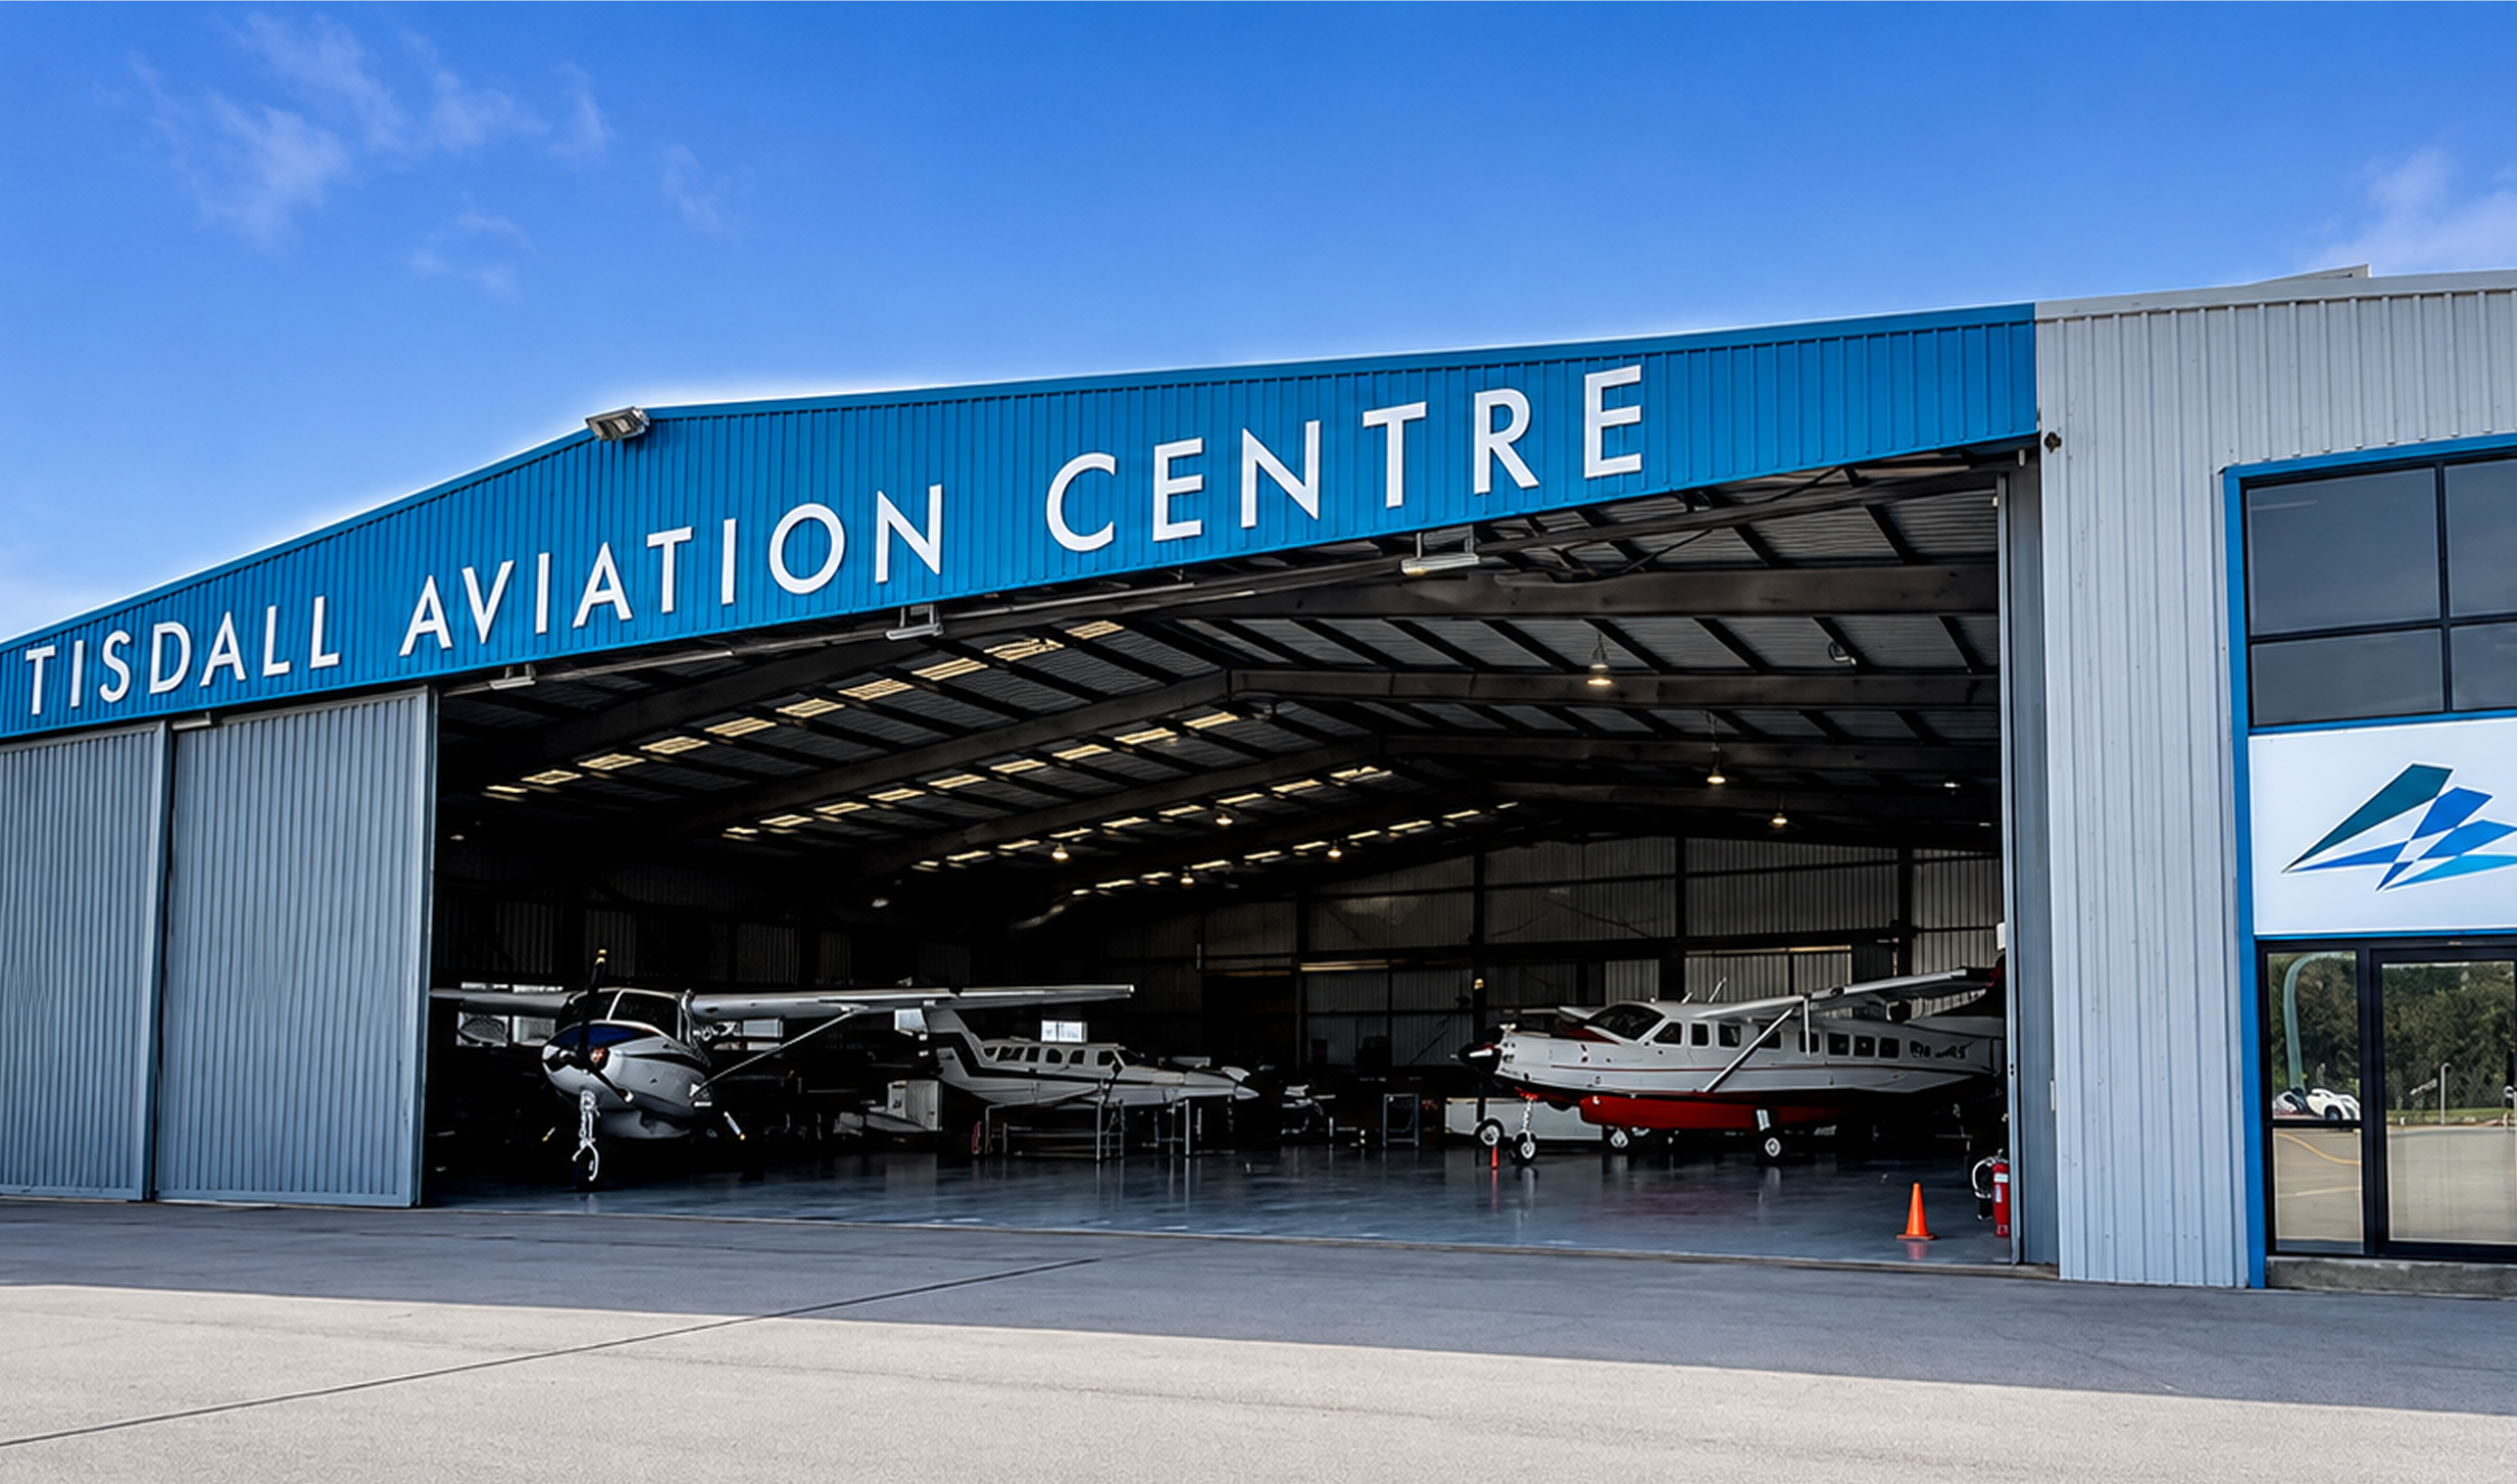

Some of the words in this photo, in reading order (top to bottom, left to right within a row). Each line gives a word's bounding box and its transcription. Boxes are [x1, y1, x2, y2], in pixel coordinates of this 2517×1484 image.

[25, 595, 341, 716] TISDALL
[399, 483, 943, 658] AVIATION
[1045, 364, 1646, 552] CENTRE
